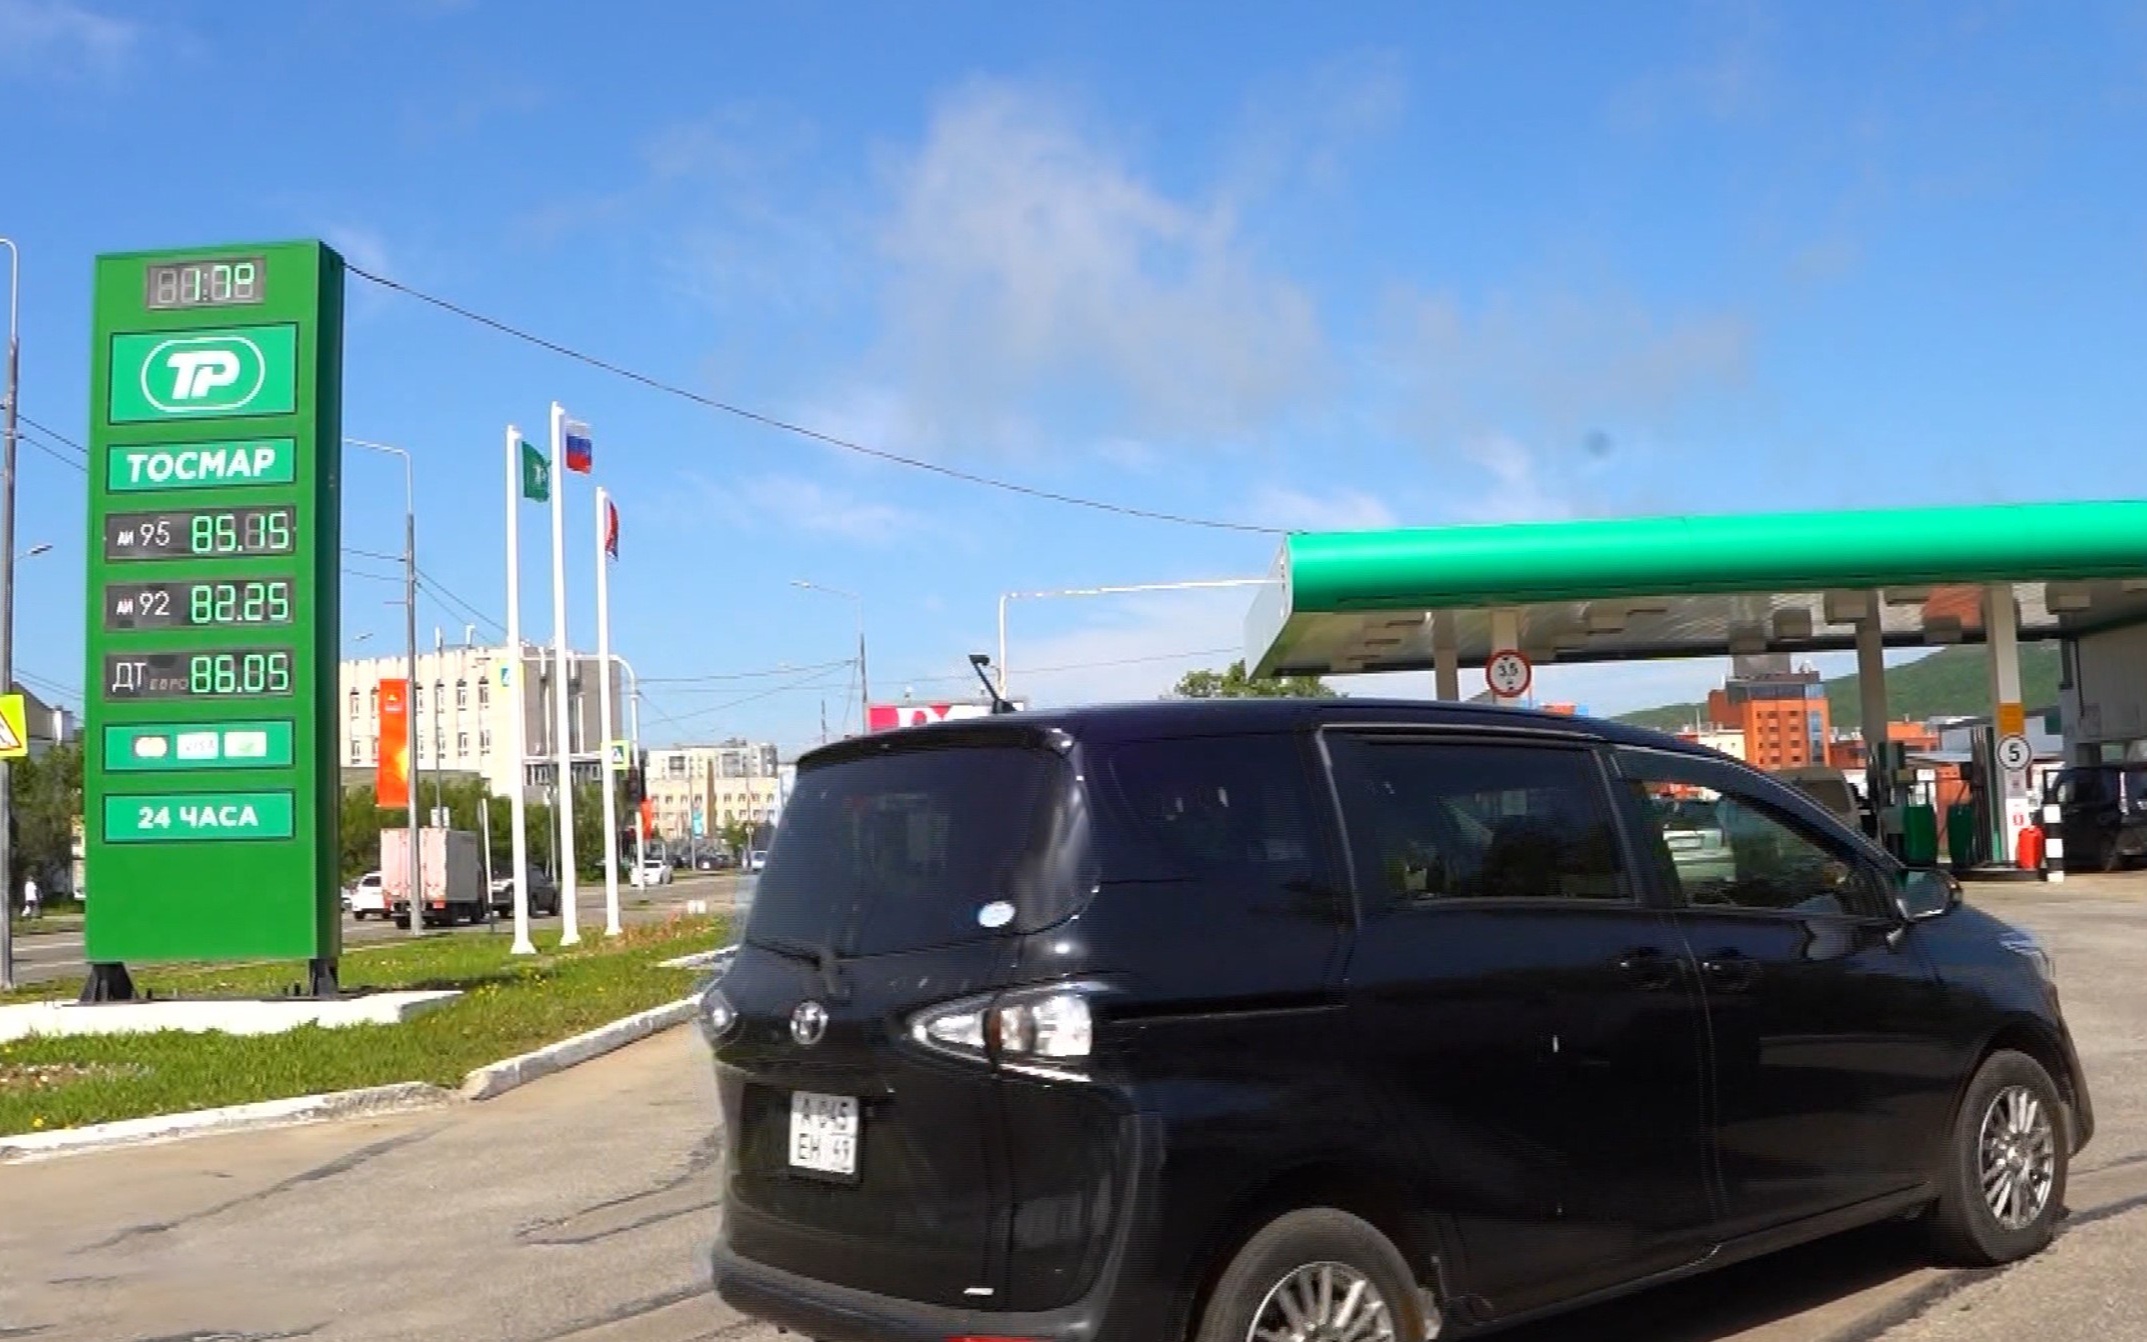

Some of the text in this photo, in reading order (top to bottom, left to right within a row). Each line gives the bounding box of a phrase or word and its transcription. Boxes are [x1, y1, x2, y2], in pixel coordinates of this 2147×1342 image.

[127, 448, 275, 483] ТОСМАР
[139, 521, 171, 546] 95
[192, 511, 289, 554] 85.15
[139, 591, 171, 616] 92
[191, 582, 289, 624] 82.25
[112, 662, 147, 692] ДТ
[191, 652, 289, 693] 86.05
[2008, 742, 2020, 763] 5
[137, 803, 259, 829] 24 ЧАСА
